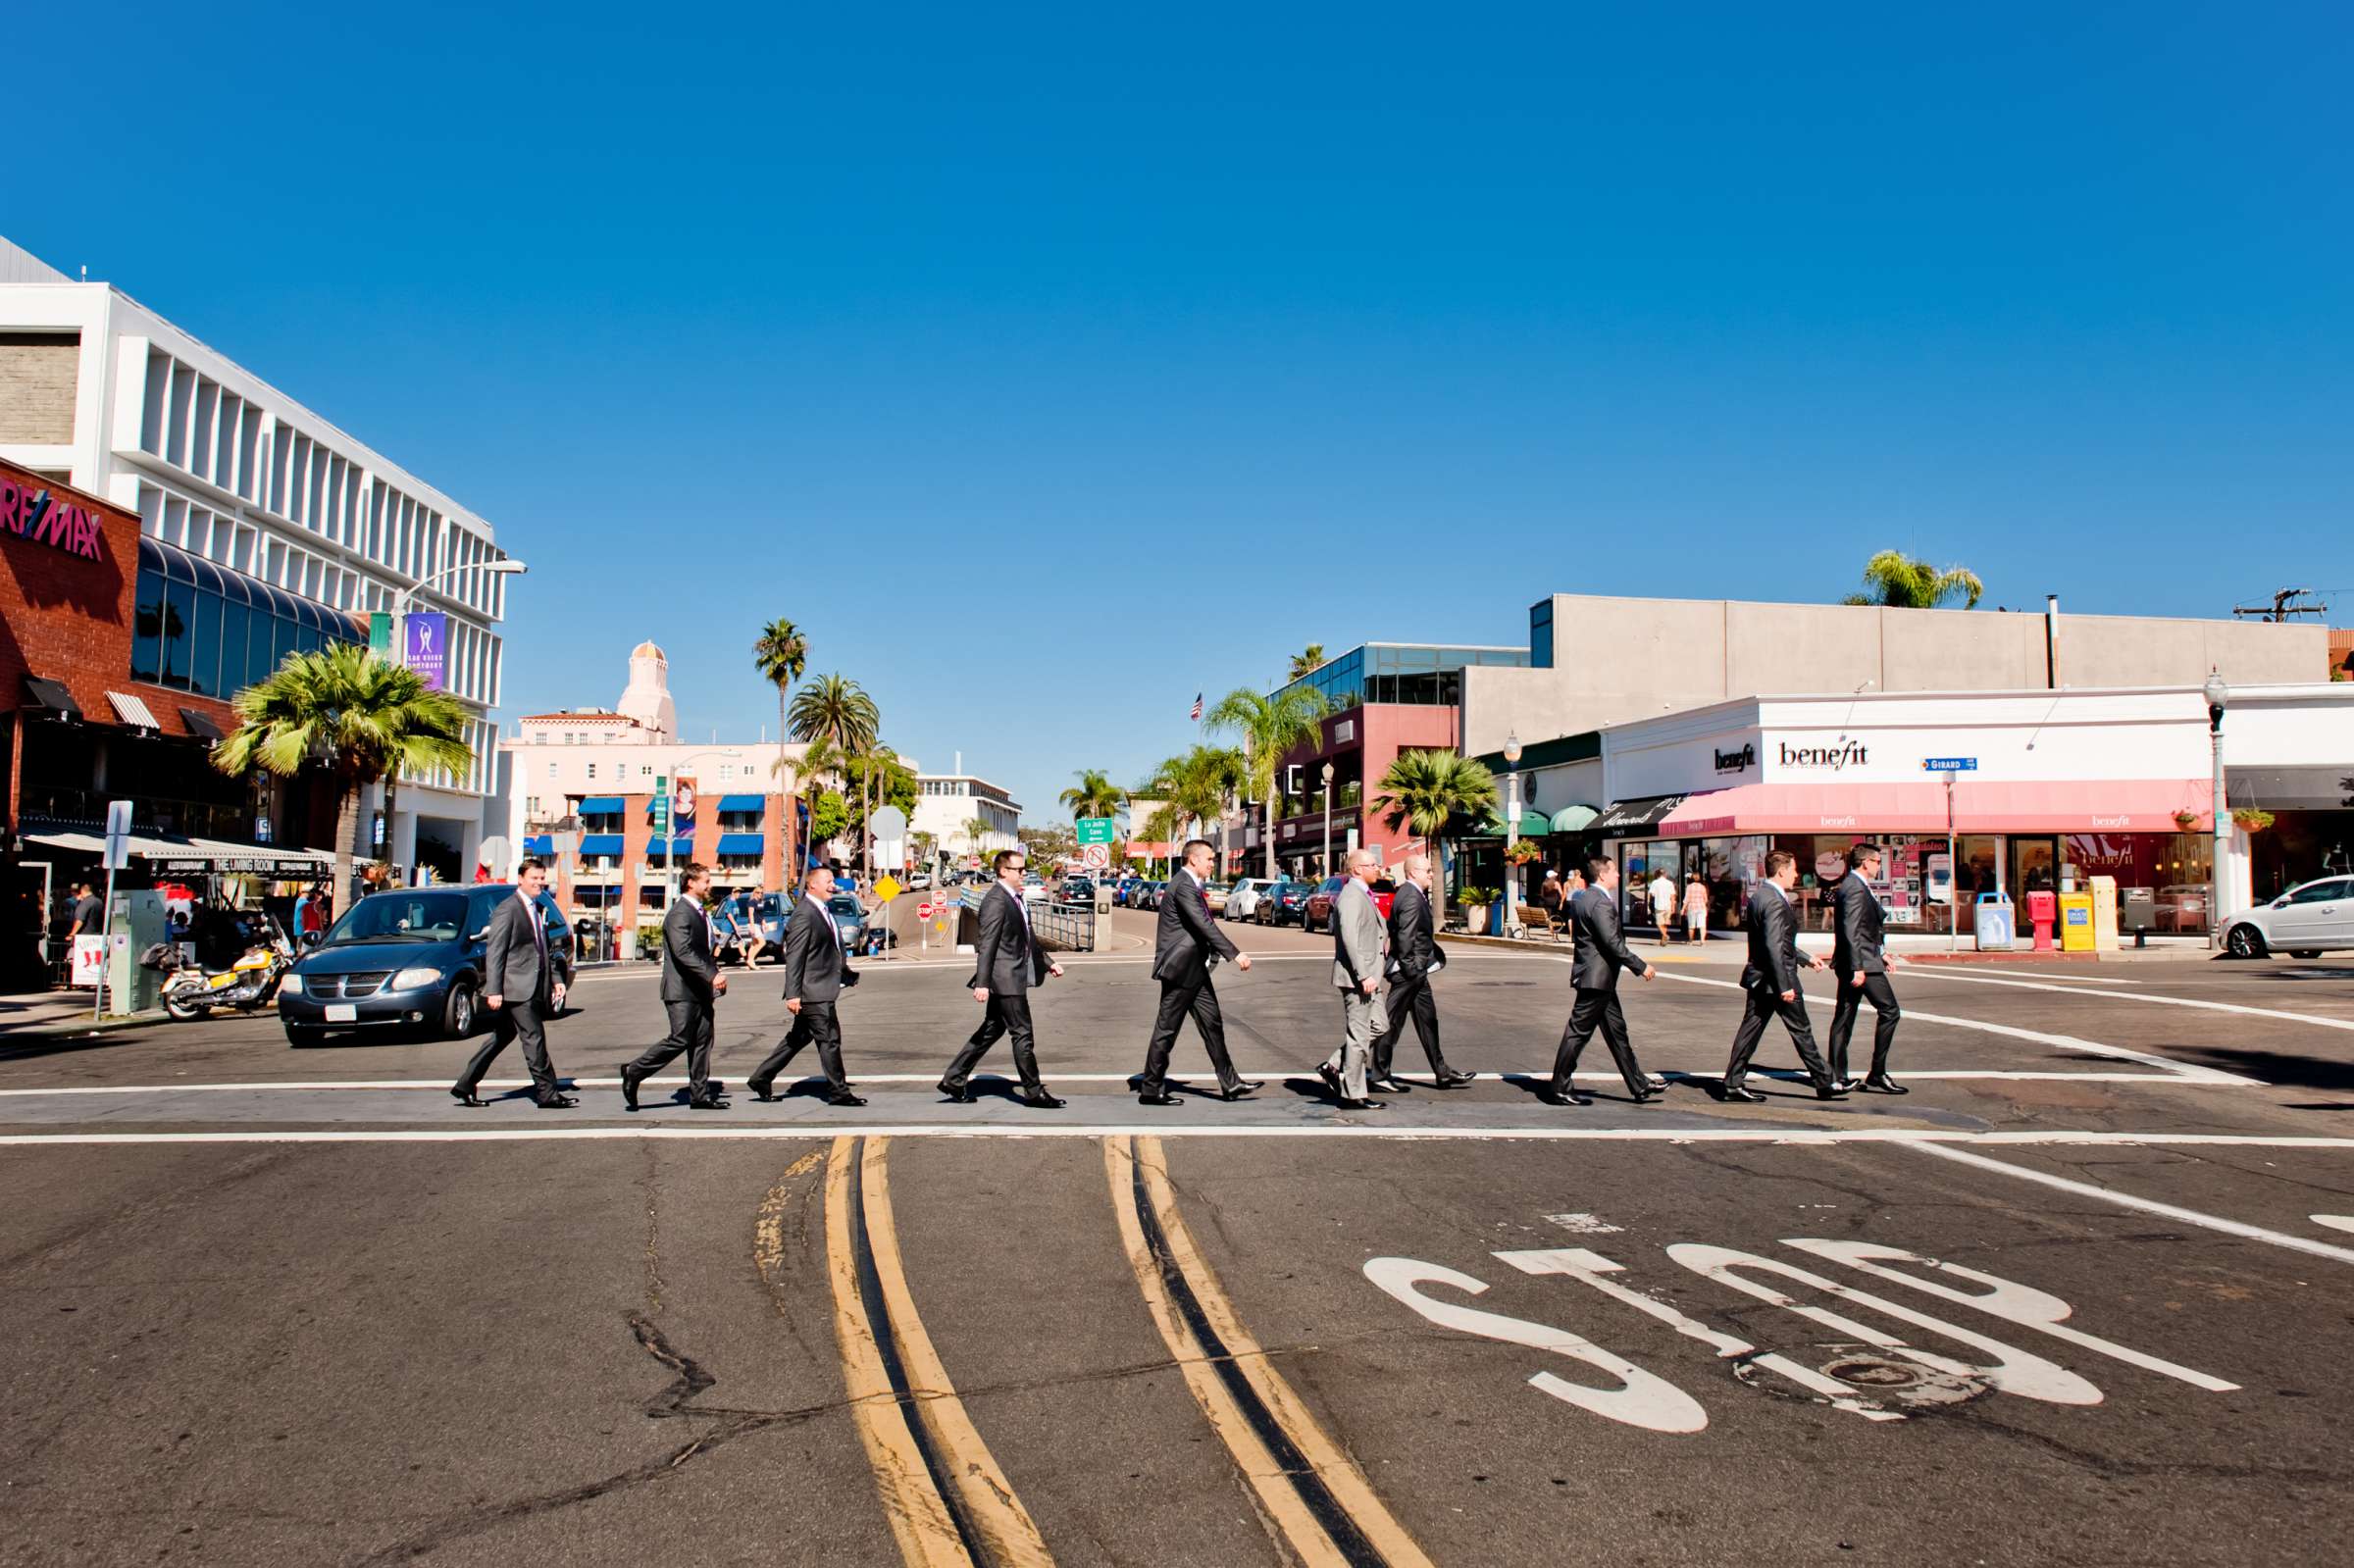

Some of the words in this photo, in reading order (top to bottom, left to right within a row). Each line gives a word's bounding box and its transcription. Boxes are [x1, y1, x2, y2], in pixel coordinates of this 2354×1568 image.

[1714, 743, 1756, 773] benefit
[1779, 740, 1868, 771] benefit
[1820, 815, 1857, 827] benefit
[2092, 815, 2130, 827] benefit
[213, 859, 230, 872] THE
[230, 859, 253, 872] LIVING
[254, 859, 275, 872] ROOM
[1362, 1238, 2242, 1434] STOP
